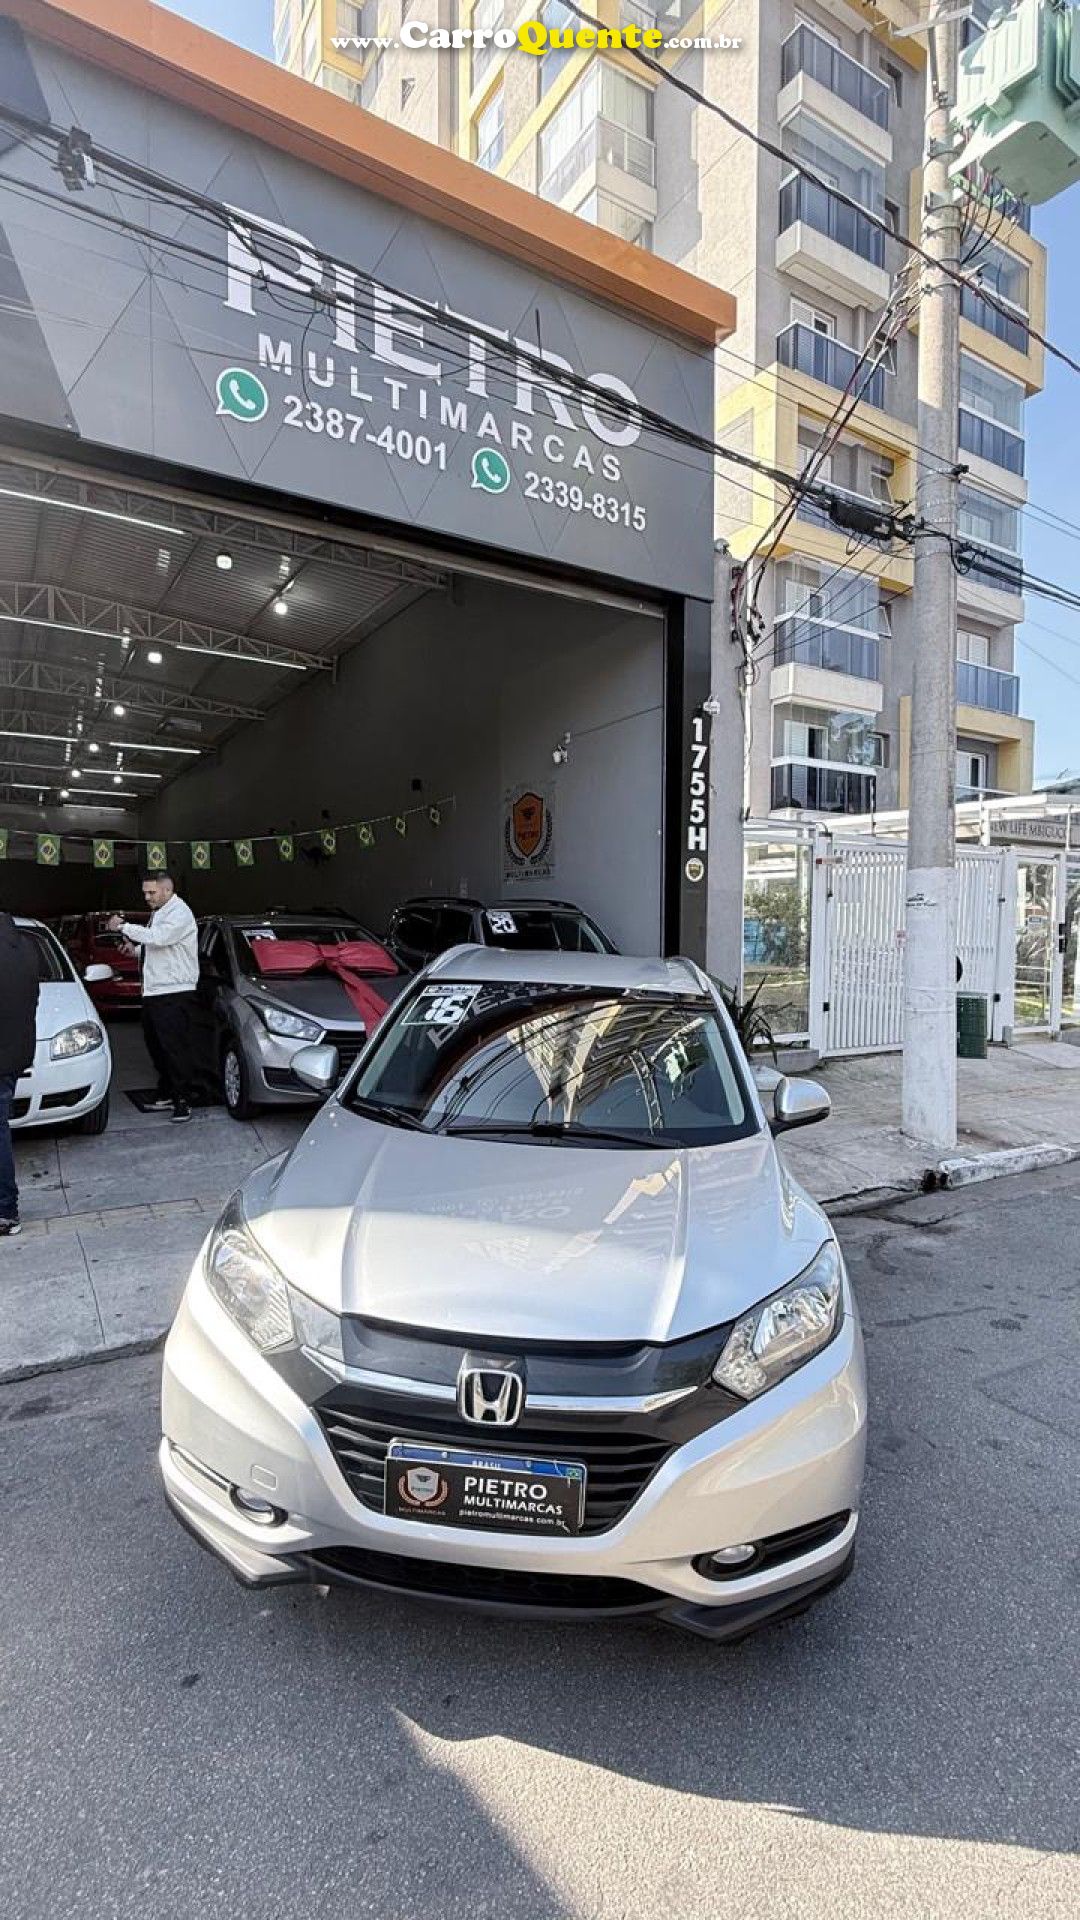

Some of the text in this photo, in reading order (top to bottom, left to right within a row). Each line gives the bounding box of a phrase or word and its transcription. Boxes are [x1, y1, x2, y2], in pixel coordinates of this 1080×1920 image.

[222, 202, 643, 447] PIETRO
[257, 332, 622, 482] MULTIMARCAS
[283, 395, 448, 470] 2387-4001
[523, 471, 647, 531] 2339-8315
[1008, 821, 1027, 835] LIFE
[490, 917, 518, 934] 20
[424, 995, 467, 1024] 16
[463, 1475, 548, 1501] PIETRO
[462, 1494, 564, 1517] MULTIMARCAS
